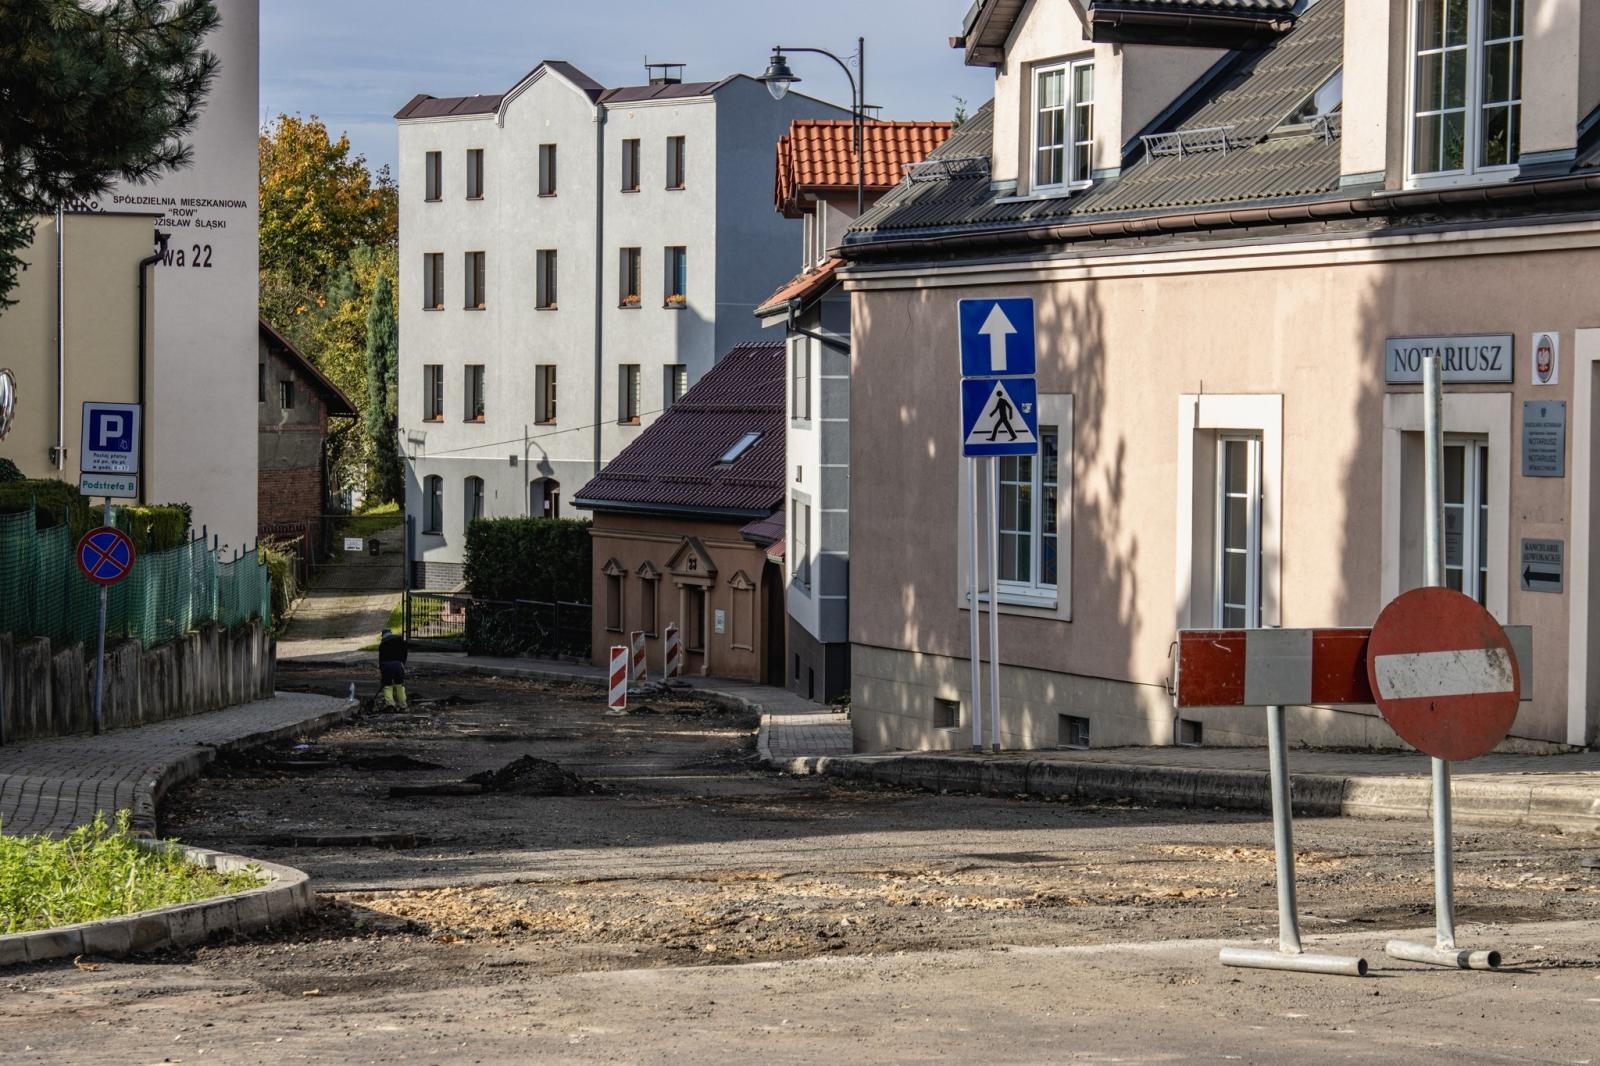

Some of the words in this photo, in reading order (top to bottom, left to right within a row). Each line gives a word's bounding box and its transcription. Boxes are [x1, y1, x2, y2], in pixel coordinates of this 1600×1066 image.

[113, 194, 176, 206] SPÓŁDZIELNIA
[180, 198, 247, 208] MIESZKANIOWA
[168, 208, 198, 217] "ROW"
[195, 218, 227, 230] ŚLĄSKI
[154, 248, 185, 267] wa
[192, 243, 212, 268] 22
[99, 415, 124, 446] P
[83, 481, 125, 490] Podstrefa
[128, 482, 134, 490] B
